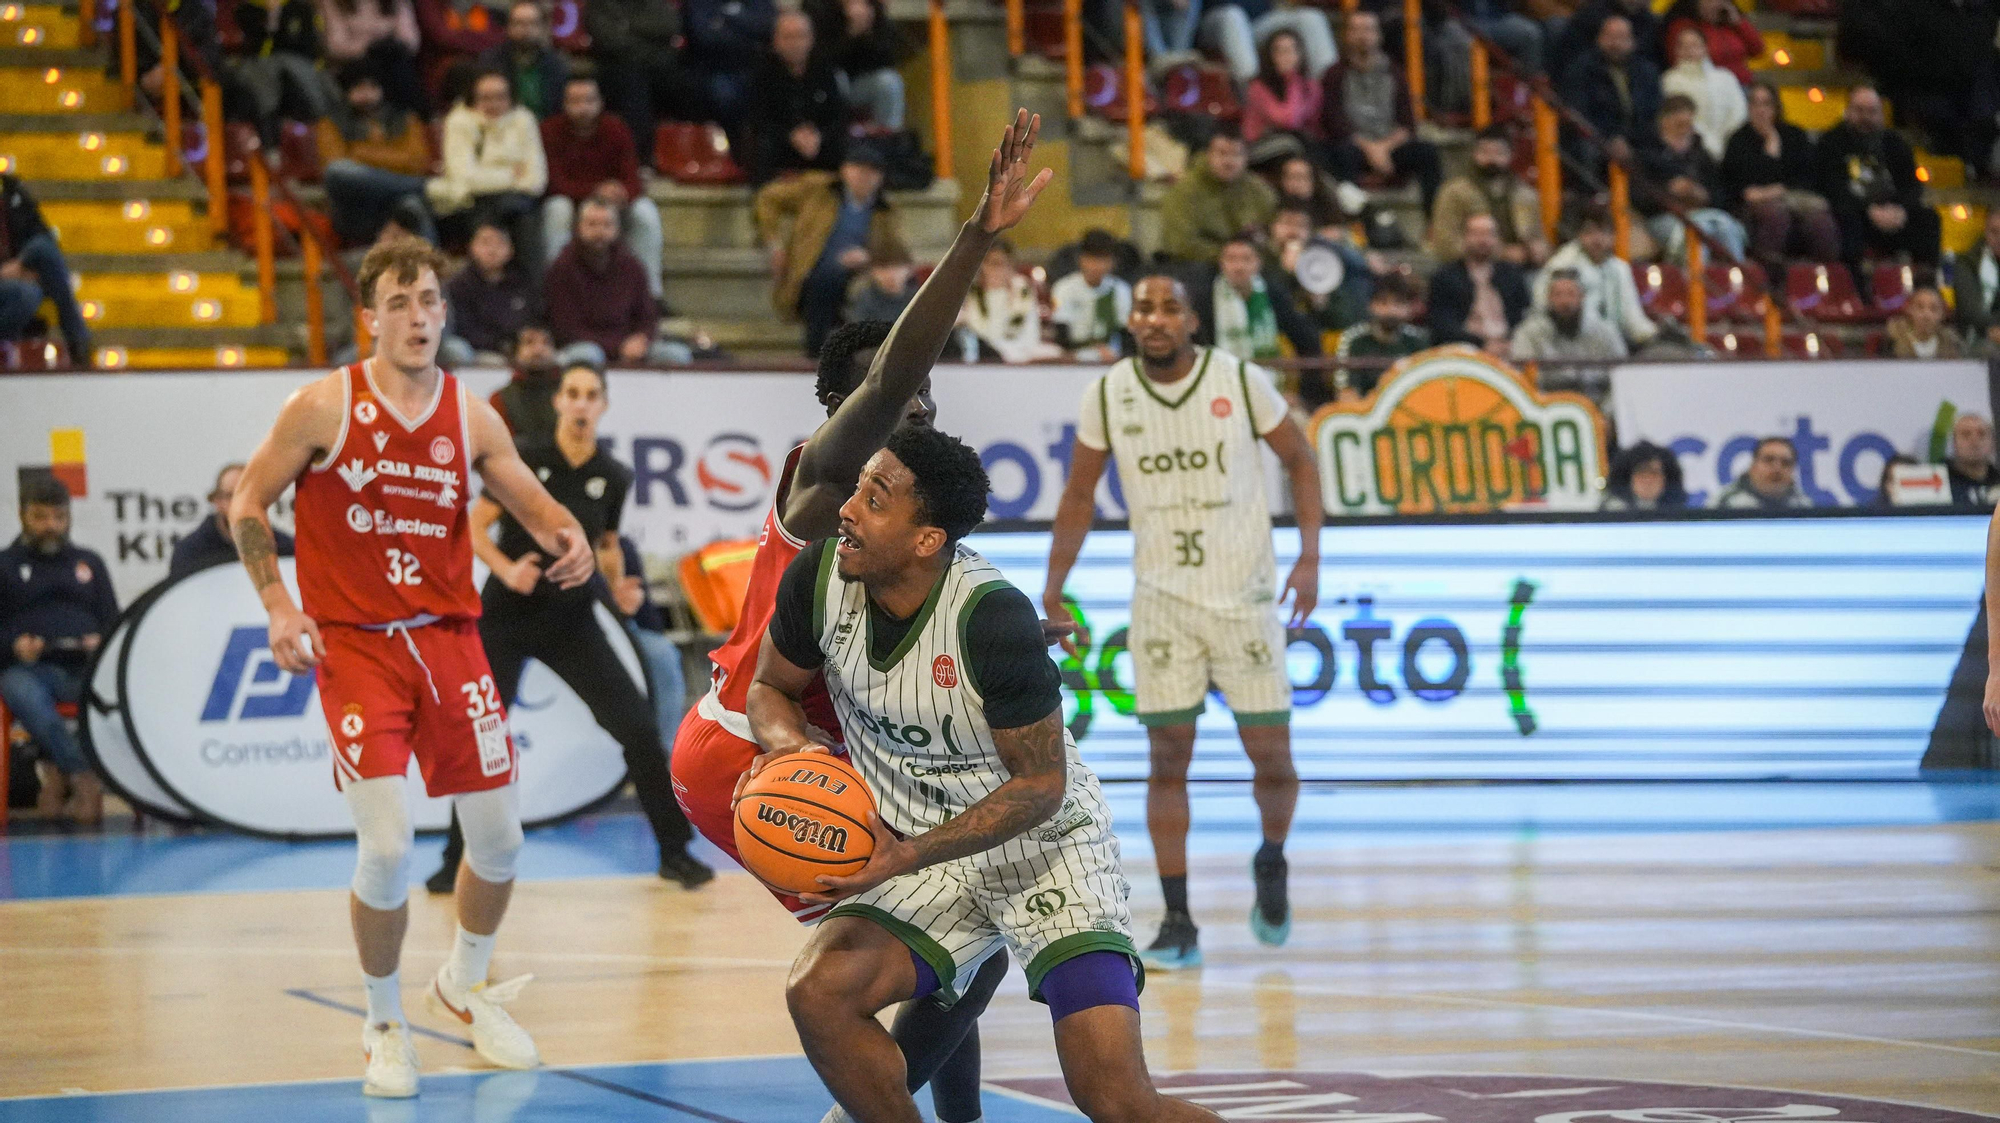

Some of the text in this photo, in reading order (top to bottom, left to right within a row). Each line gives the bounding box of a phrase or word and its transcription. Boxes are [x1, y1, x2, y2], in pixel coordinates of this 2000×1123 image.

[376, 459, 460, 486] CAJA RURAL
[1138, 446, 1208, 475] coto
[106, 489, 199, 521] The
[1173, 529, 1206, 567] 35
[386, 548, 423, 586] 32
[461, 674, 500, 720] 32
[771, 769, 849, 795] EVO NXT
[757, 802, 849, 854] Wilson
[1042, 907, 1064, 923] HOTELS
